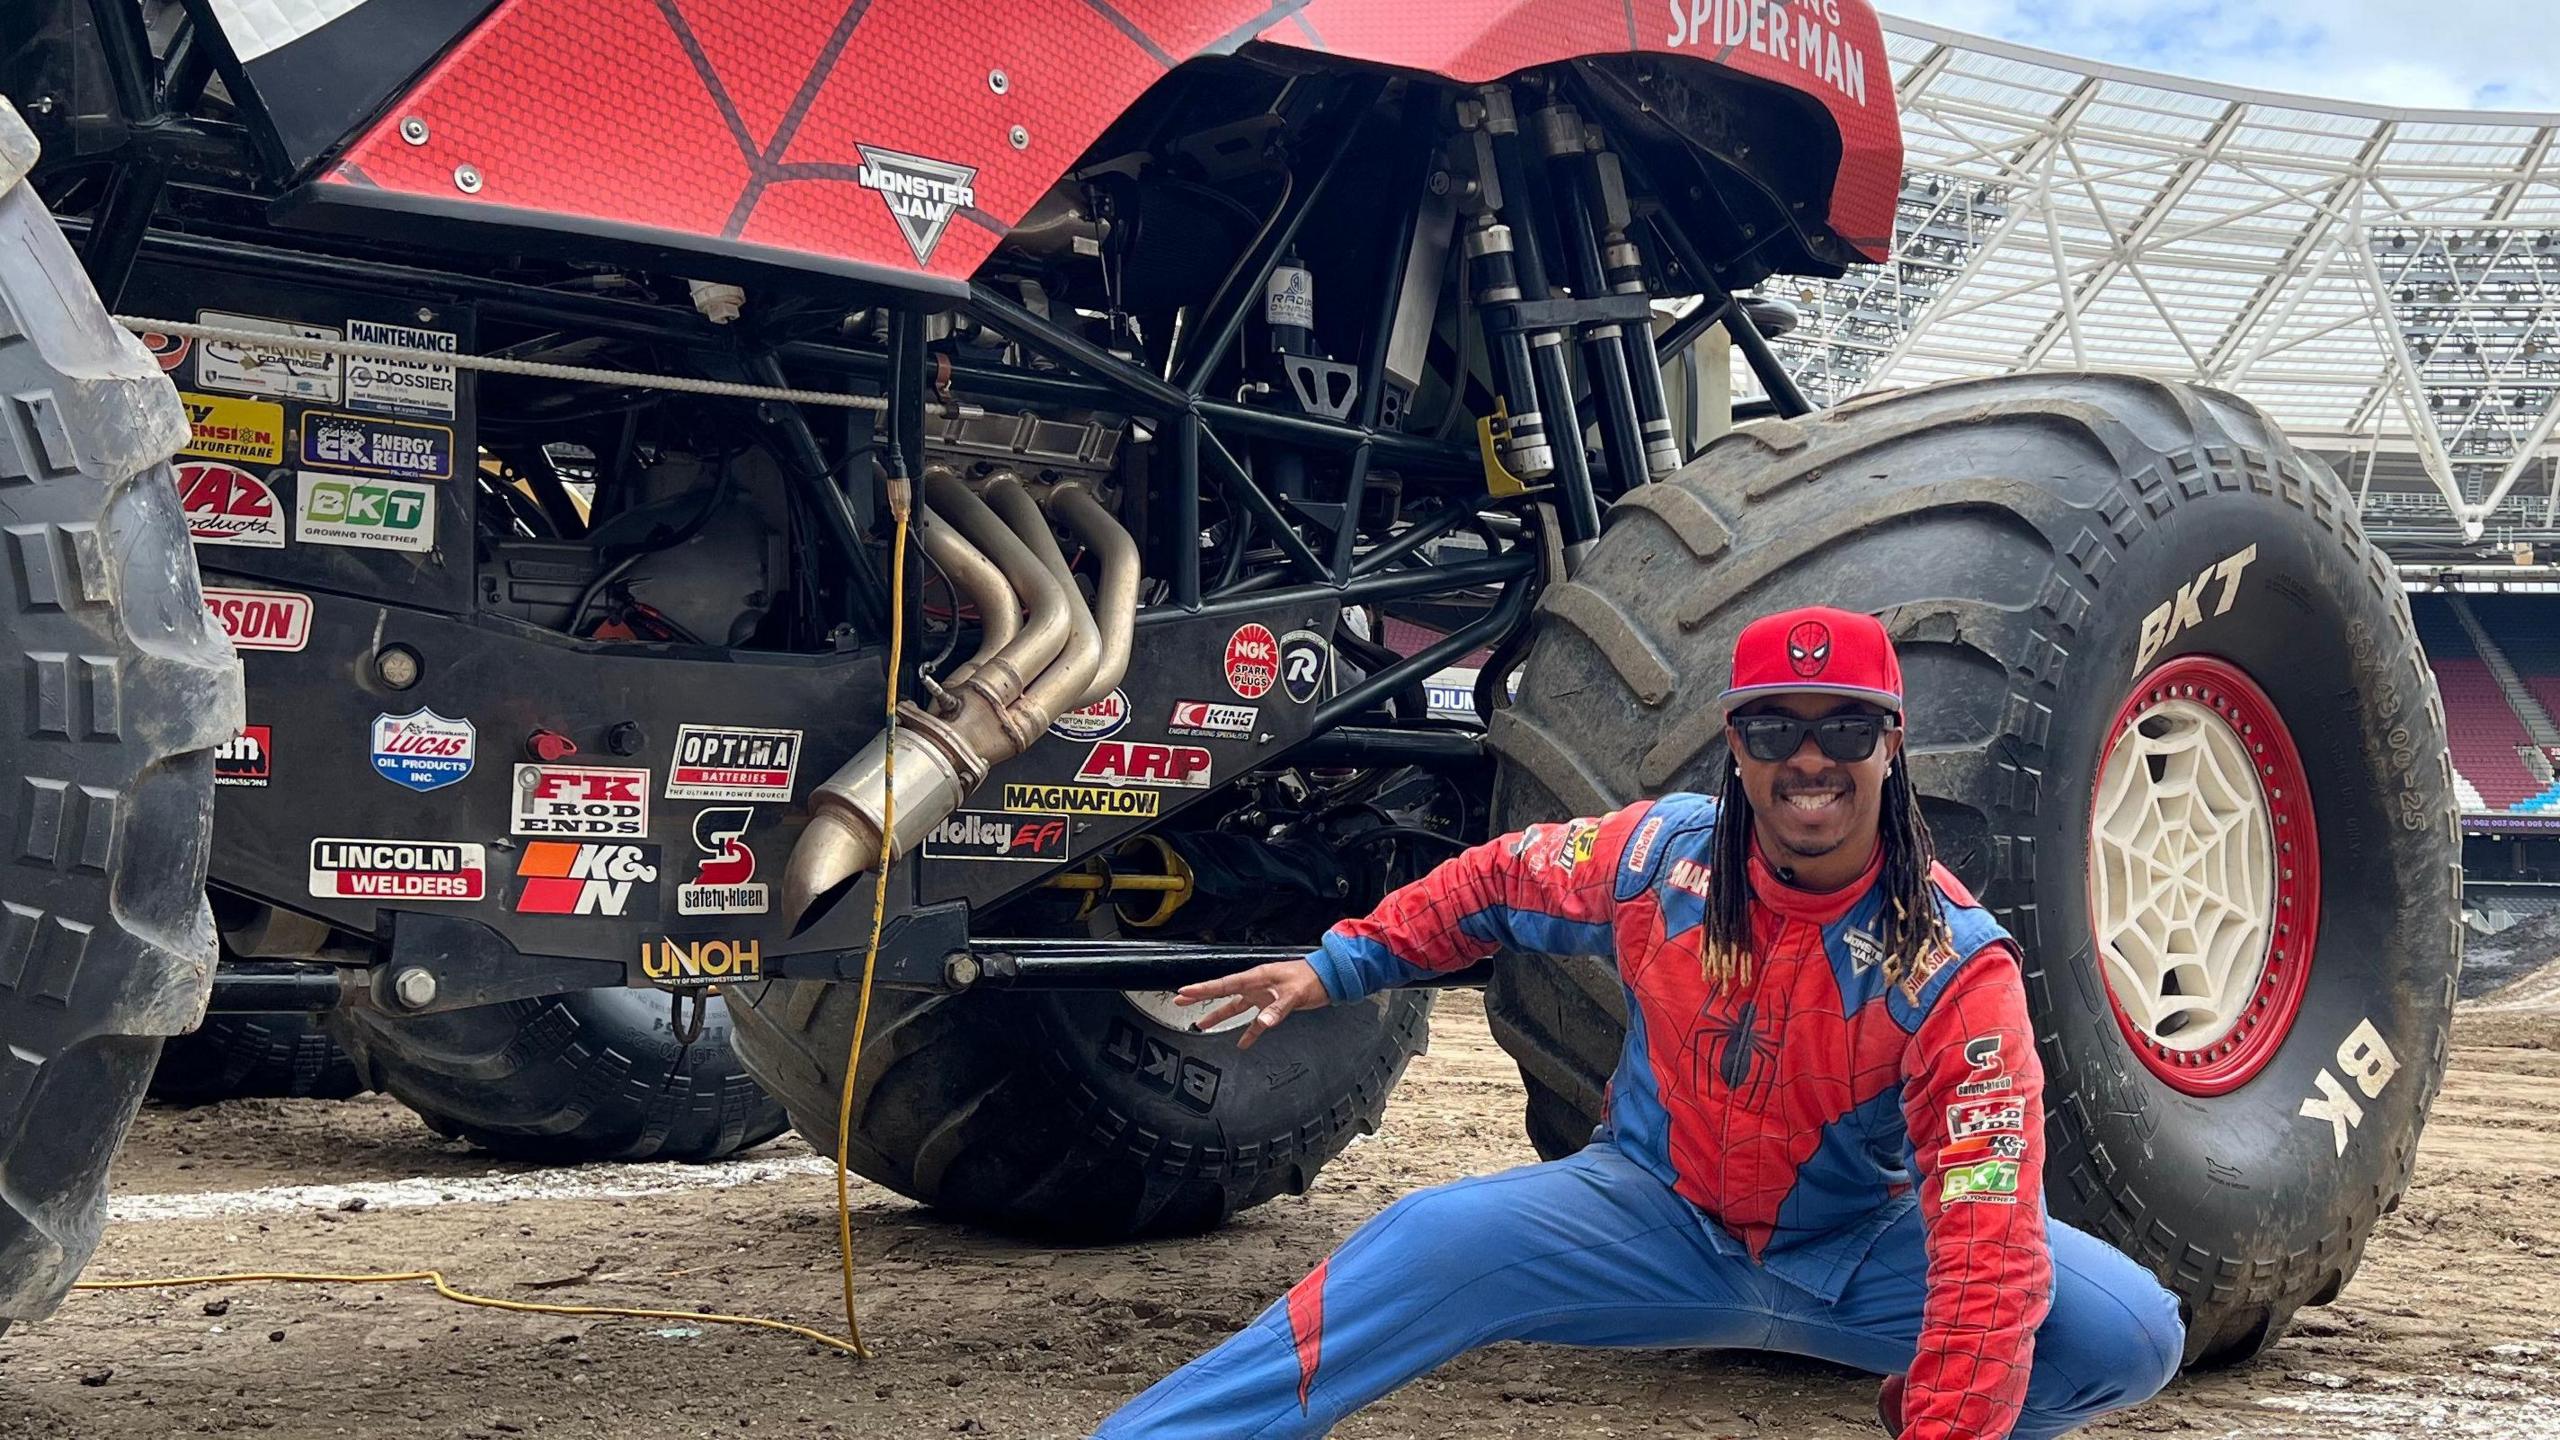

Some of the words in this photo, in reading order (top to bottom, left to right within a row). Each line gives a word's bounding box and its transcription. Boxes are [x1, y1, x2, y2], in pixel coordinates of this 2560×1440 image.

[1667, 0, 1866, 107] SPIDER-MAN
[859, 165, 974, 208] MONSTER
[894, 196, 945, 222] JAM
[351, 322, 454, 353] MAINTENANCE
[376, 369, 454, 392] DOSSIER
[372, 433, 434, 455] ENERGY
[372, 449, 437, 471] RELEASE
[310, 487, 422, 523] BKT
[304, 527, 357, 539] GROWING
[360, 531, 419, 544] TOGETHER
[2131, 542, 2257, 682] BKT
[1234, 641, 1271, 660] NGK
[1234, 675, 1268, 687] PLUGS
[1235, 664, 1268, 676] SPARK
[1058, 717, 1083, 725] PISTON
[1085, 719, 1106, 727] RINGS
[1206, 709, 1254, 726] KING
[1168, 727, 1191, 736] ENGINE
[384, 735, 467, 756] LUCAS
[684, 736, 788, 768] OPTIMA
[377, 758, 398, 768] OIL
[402, 759, 467, 772] PRODUCTS
[1080, 742, 1211, 780] ARP
[533, 773, 641, 802] FK
[701, 771, 767, 784] BATTERIES
[669, 788, 683, 796] THE
[686, 789, 722, 797] ULTIMATE
[726, 790, 753, 798] POWER
[1006, 786, 1157, 814] MAGNAFLOW
[549, 802, 641, 818] ROD
[520, 818, 641, 834] ENDS
[1011, 820, 1066, 853] EFI
[321, 844, 455, 871] LINCOLN
[350, 874, 468, 896] WELDERS
[641, 935, 760, 978] UNOH
[1106, 1025, 1218, 1105] BKT
[1945, 1166, 2016, 1196] BKT
